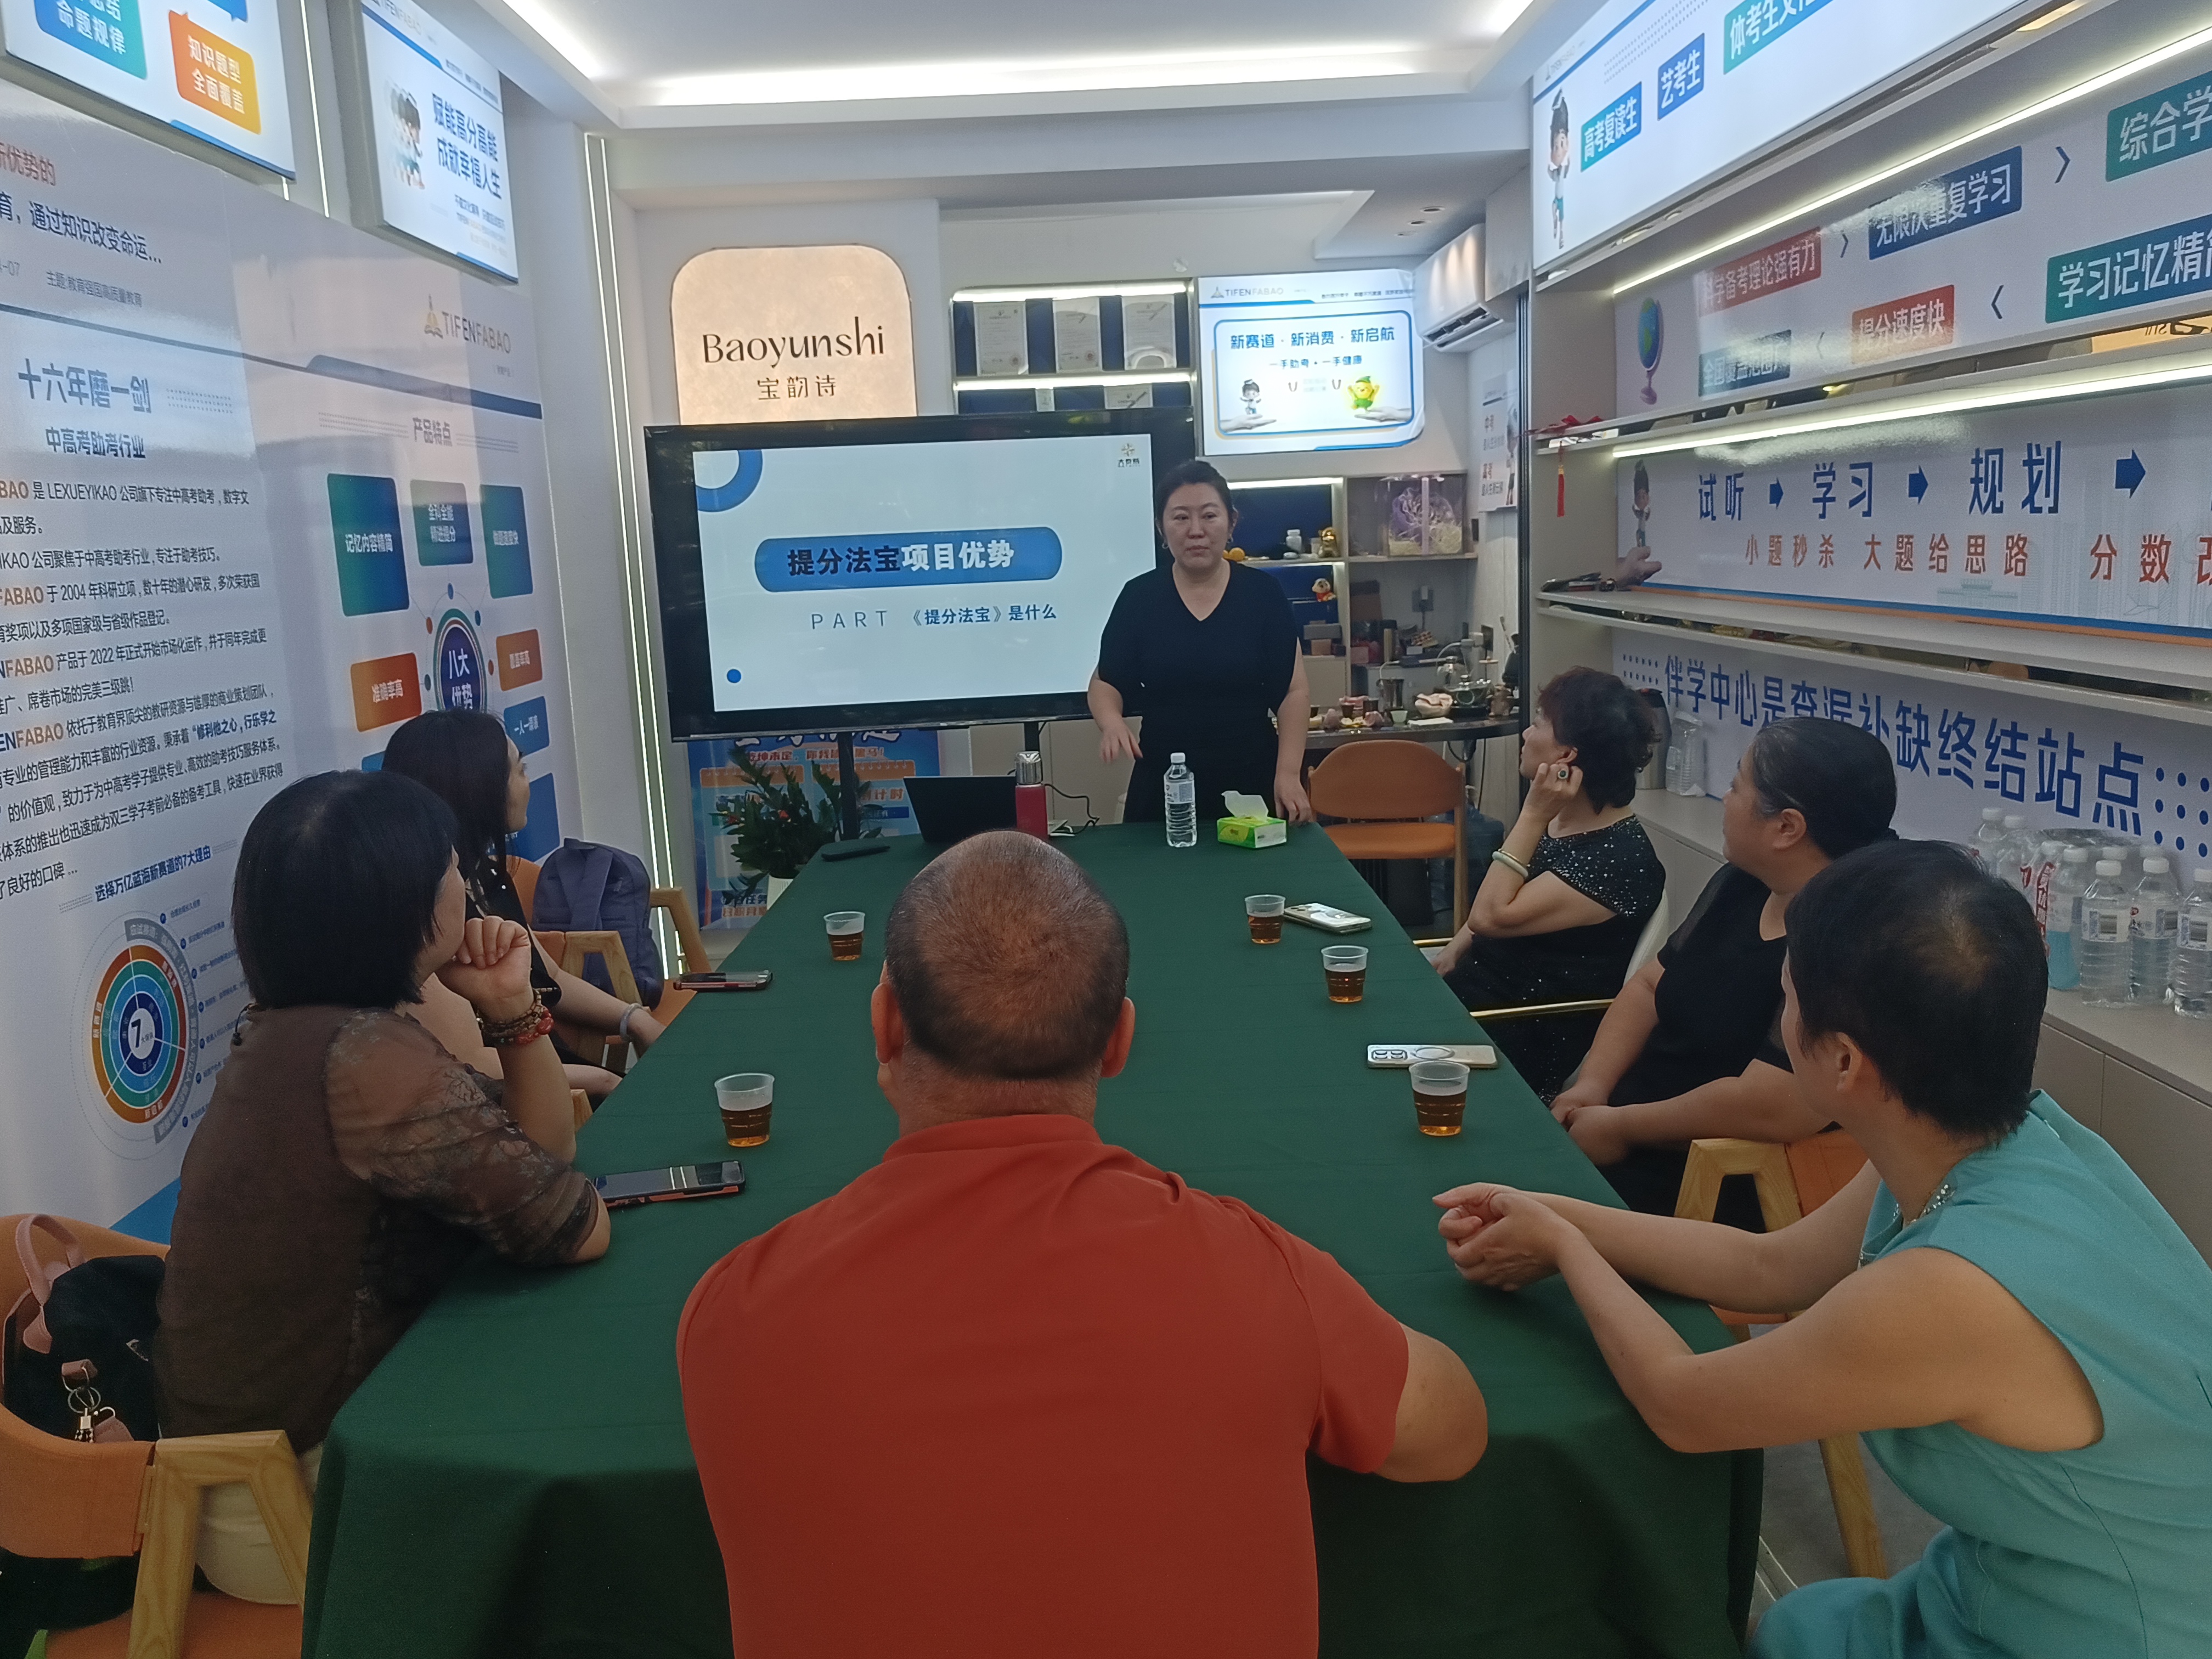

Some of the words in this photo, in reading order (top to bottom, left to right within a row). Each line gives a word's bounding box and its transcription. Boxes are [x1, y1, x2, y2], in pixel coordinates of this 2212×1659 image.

[1730, 0, 1815, 60] 体考生文
[188, 35, 241, 85] 知识题型
[1661, 49, 1701, 109] 艺考生
[192, 69, 245, 114] 全面覆盖
[1583, 96, 1638, 162] 高考复读生
[2119, 85, 2212, 164] 综合学
[437, 137, 502, 200] 成就幸福人生
[2058, 229, 2212, 309] 学习记忆精
[442, 311, 511, 354] TIFENFABAO
[702, 316, 884, 369] Baoyunshi
[1230, 334, 1275, 349] 新赛道
[1290, 330, 1335, 347] 新消费
[1350, 326, 1395, 343] 新启航
[18, 358, 151, 413] 十六年磨一剑
[757, 375, 836, 400] 宝韵诗
[46, 426, 145, 459] 中高考助考行业
[1699, 472, 1744, 521] 试听
[1812, 462, 1874, 519] 学习
[1969, 441, 2061, 515] 规划
[0, 516, 42, 534] 及服务。
[787, 539, 1014, 576] 提分法宝项目优势
[1745, 534, 1834, 568] 小题秒杀
[1864, 534, 2028, 577] 大题给思路
[0, 586, 43, 605] ABAO
[811, 610, 888, 630] PART
[912, 603, 1057, 626] 《提分法宝》是什么
[449, 648, 470, 679] 八大
[0, 728, 189, 788] 专业的管理能力和丰富的行业资源。秉承着
[1665, 654, 2144, 836] 伴学中心是查漏补缺终结站点
[0, 762, 283, 862] 体系的推出也迅速成为双三学子考前必备的备考工具，快速在业界获得
